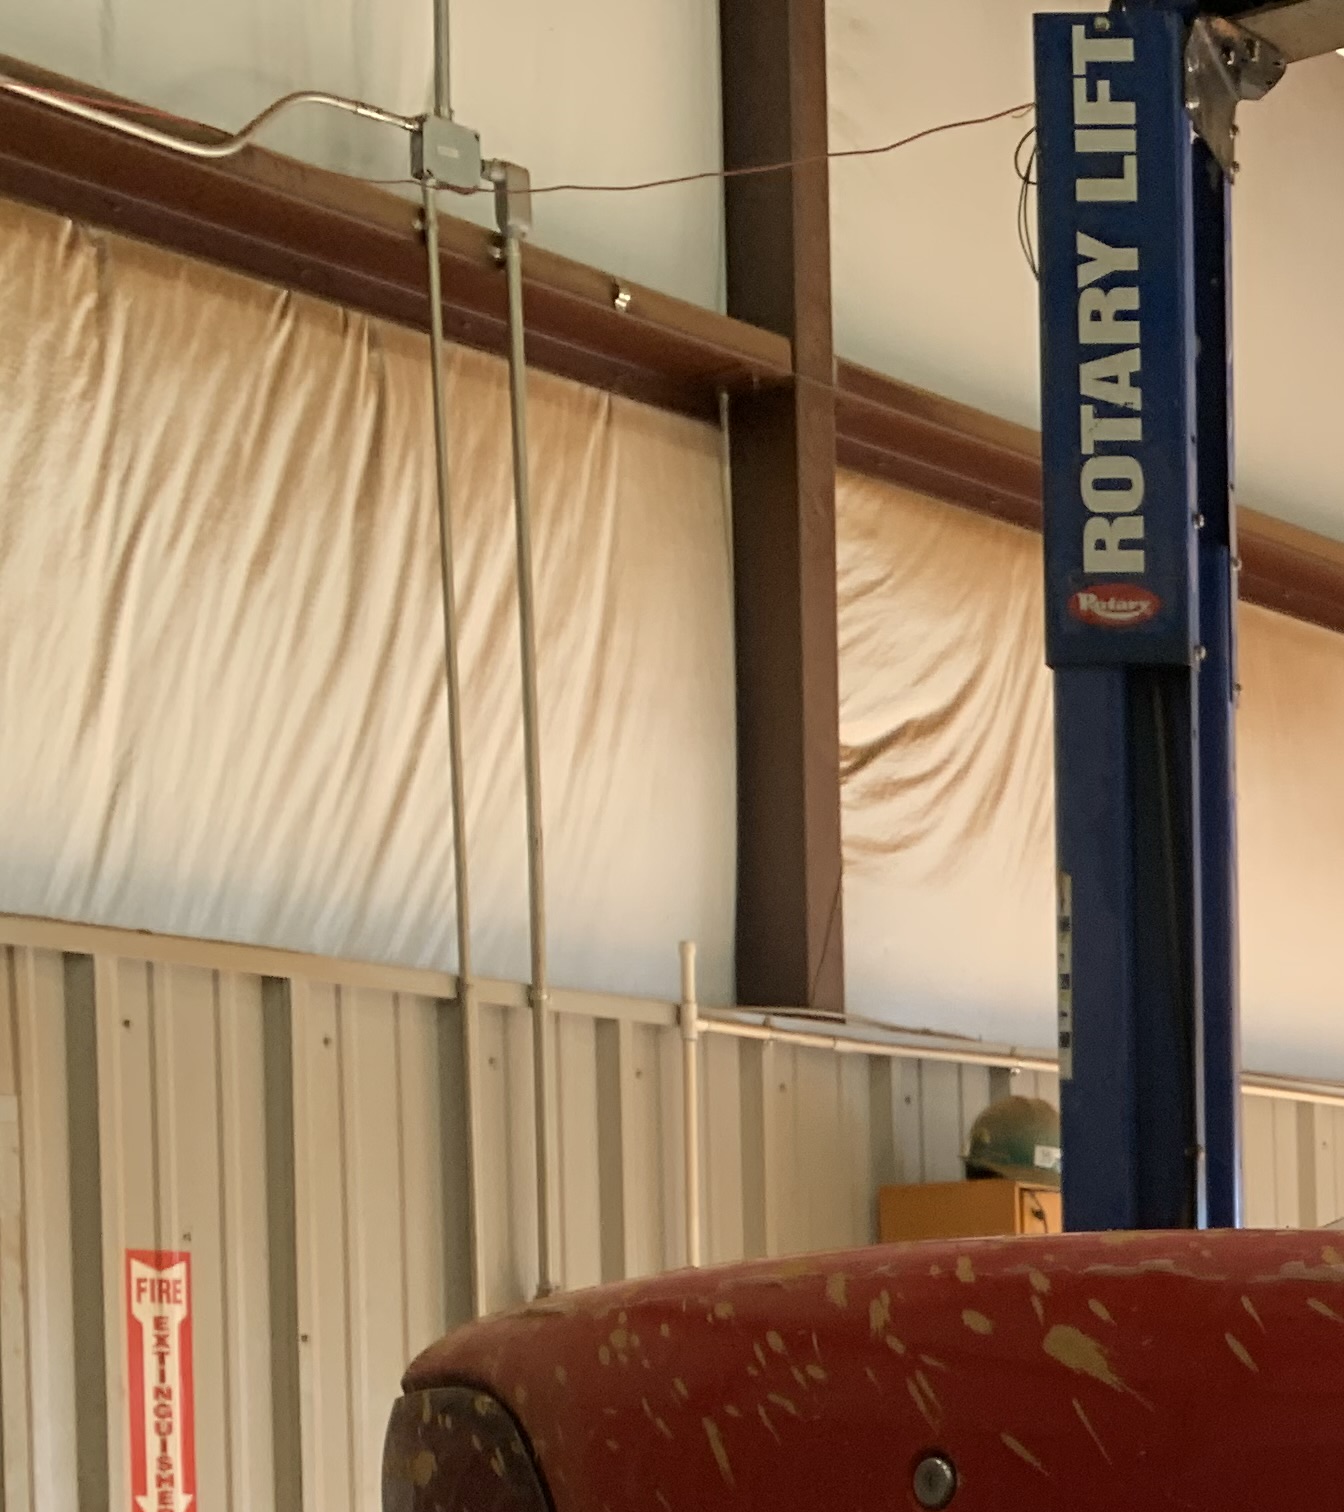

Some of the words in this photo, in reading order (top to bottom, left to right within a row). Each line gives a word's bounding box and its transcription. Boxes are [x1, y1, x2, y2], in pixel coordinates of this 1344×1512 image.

[1071, 23, 1139, 203] LIFT
[1075, 231, 1146, 575] ROTARY
[1076, 592, 1152, 619] Rotary
[135, 1277, 183, 1305] FIRE
